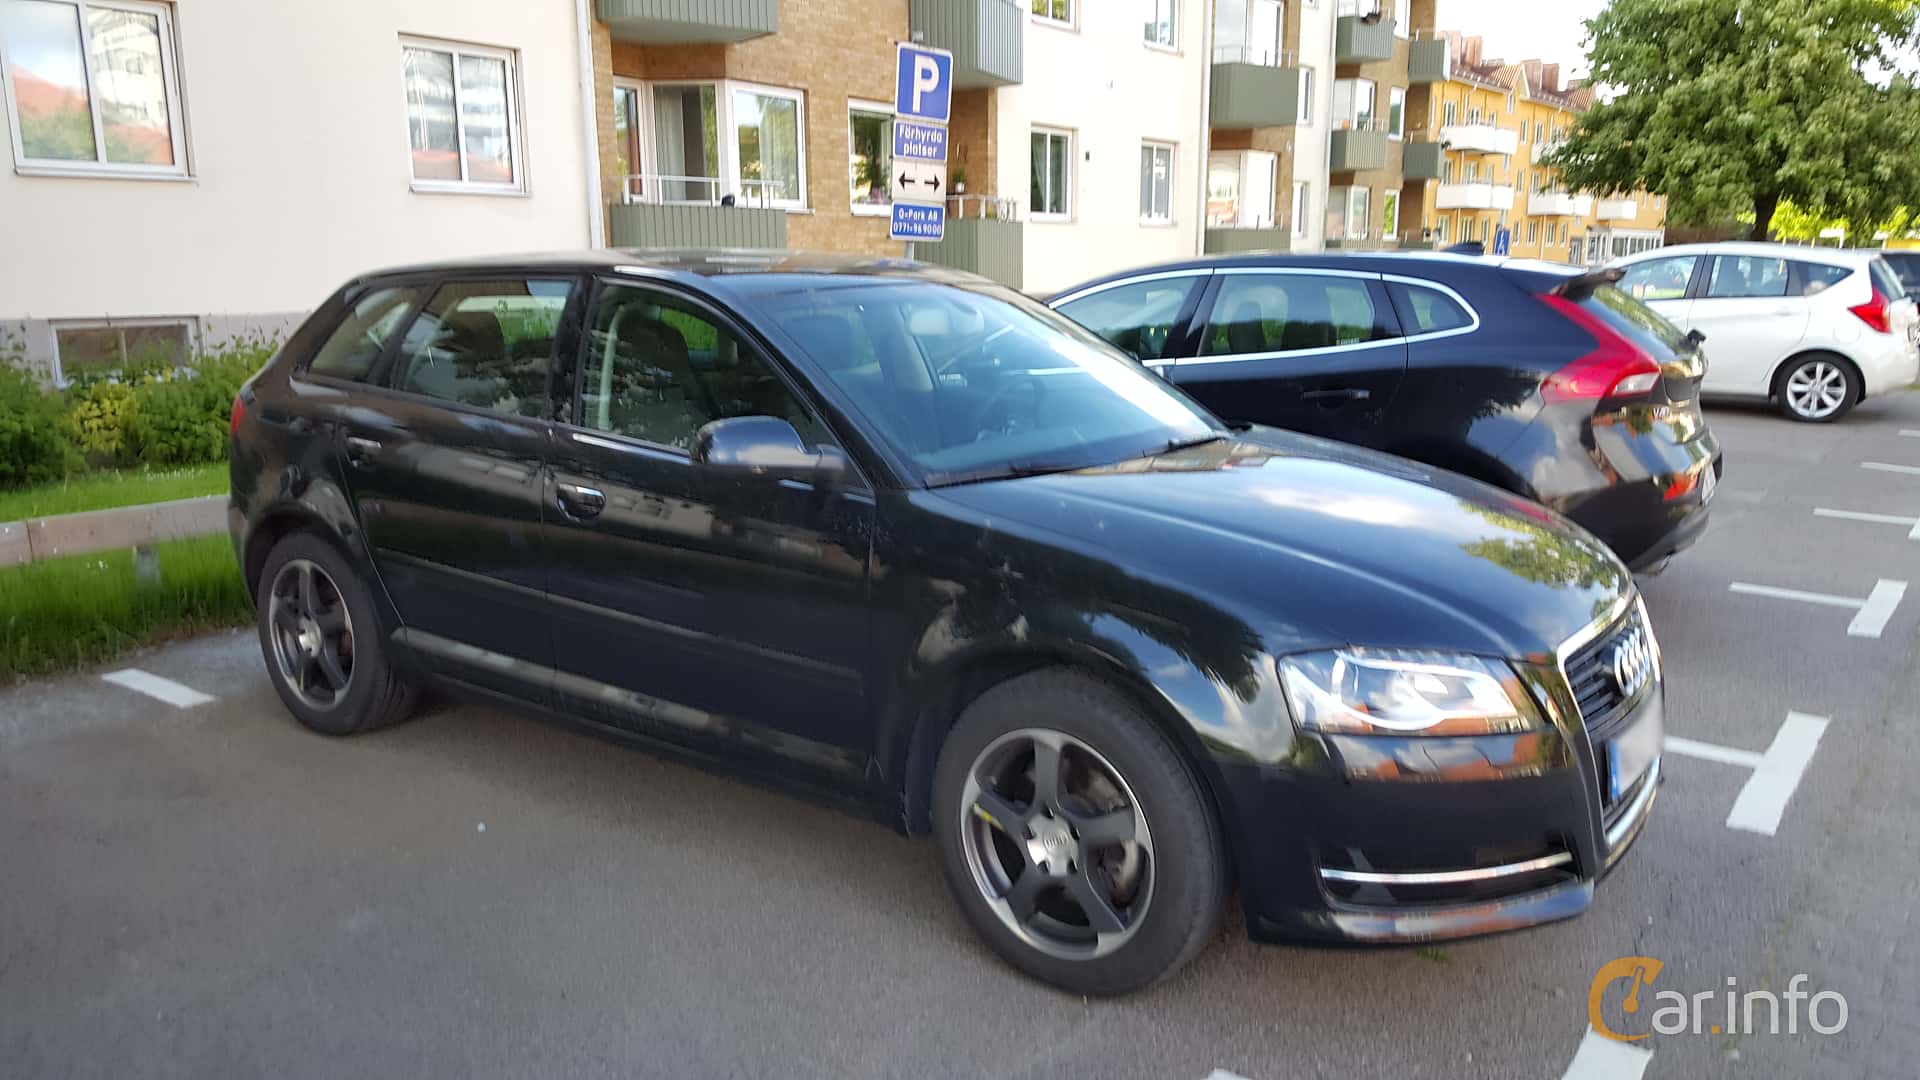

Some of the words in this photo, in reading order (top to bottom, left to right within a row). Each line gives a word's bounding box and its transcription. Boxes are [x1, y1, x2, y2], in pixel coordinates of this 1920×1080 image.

[912, 53, 940, 113] P
[899, 124, 943, 144] Förhyrda
[903, 141, 938, 158] platser
